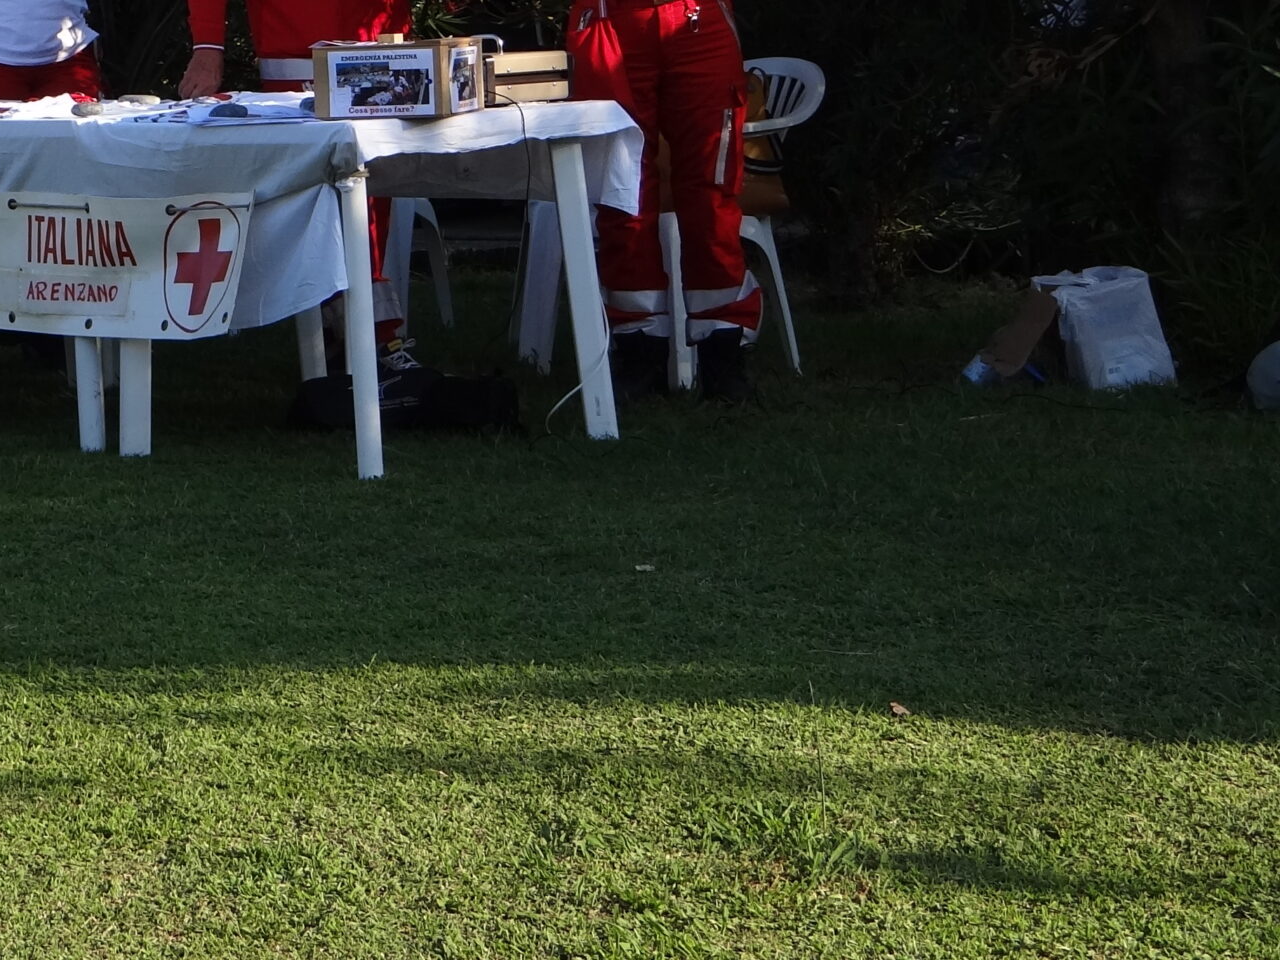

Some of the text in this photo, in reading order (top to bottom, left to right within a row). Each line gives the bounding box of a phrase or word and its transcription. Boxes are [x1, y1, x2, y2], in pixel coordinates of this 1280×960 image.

[340, 53, 418, 62] EMERGENZA PALESTINA
[348, 105, 415, 115] Cosa posso fare?
[27, 214, 137, 267] ITALIANA
[26, 281, 119, 303] ARENZANO
